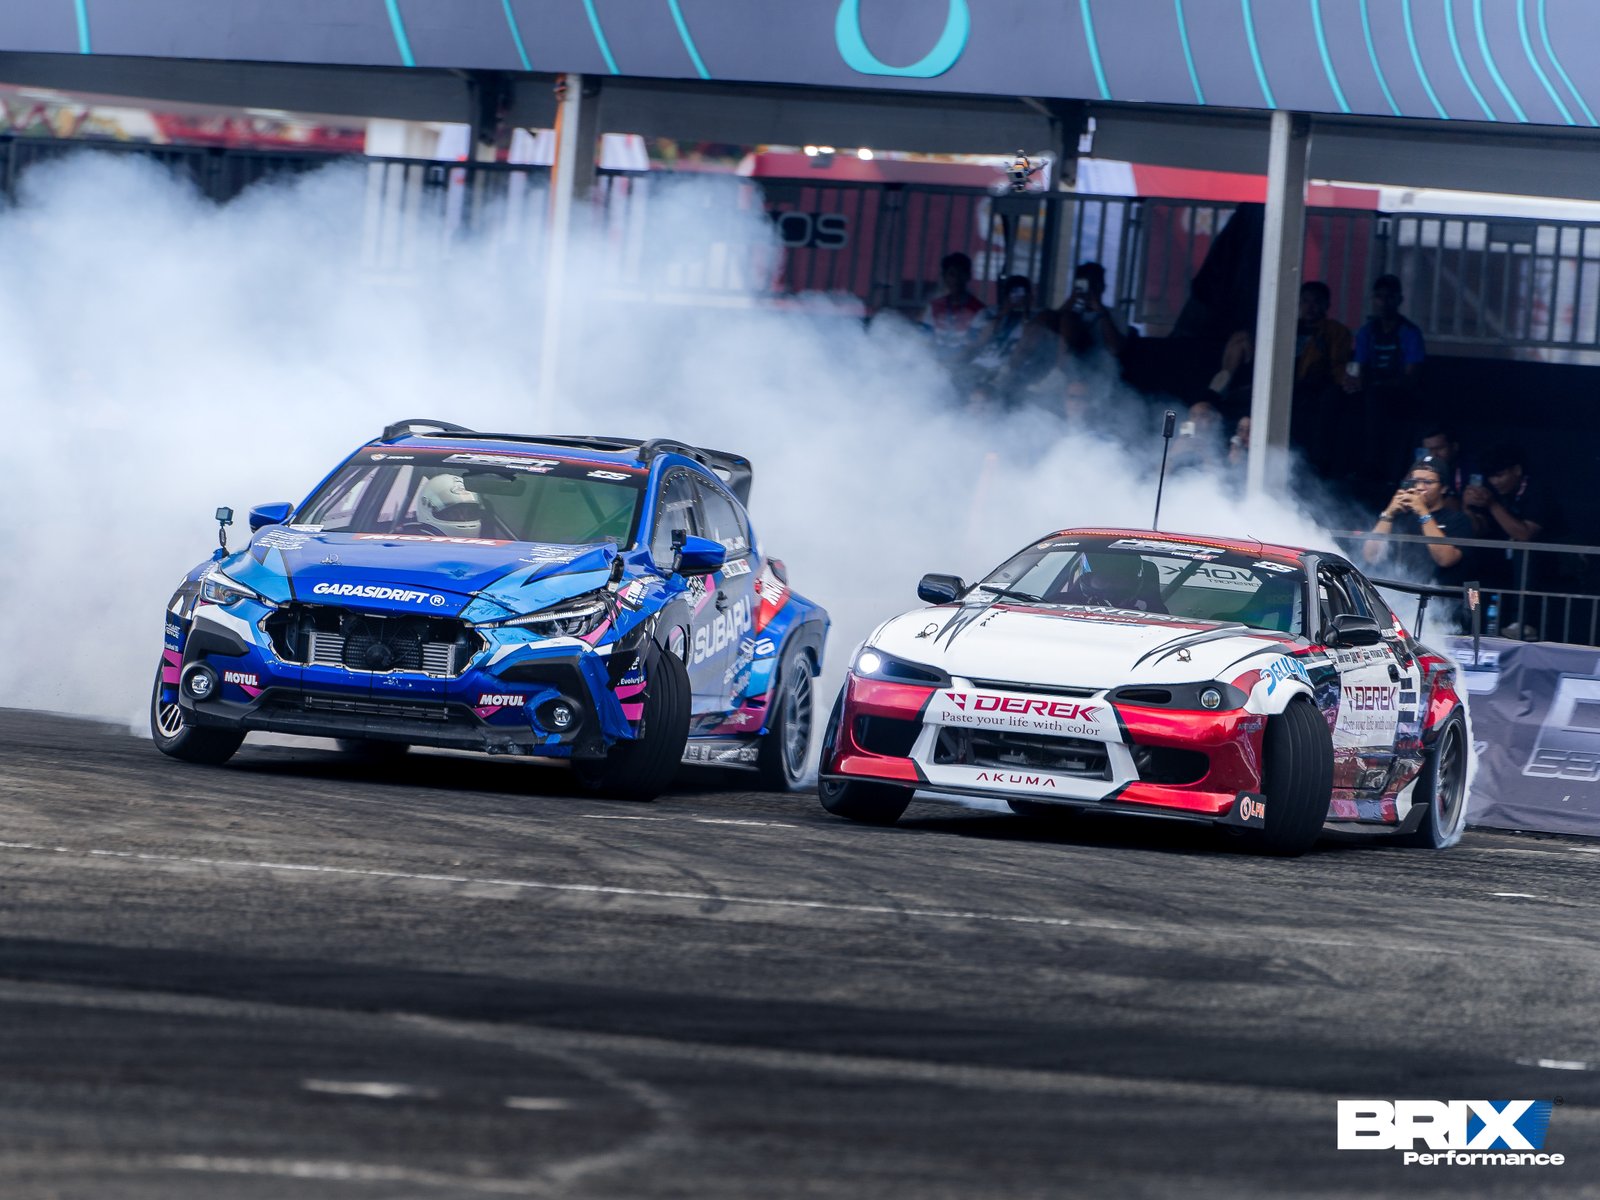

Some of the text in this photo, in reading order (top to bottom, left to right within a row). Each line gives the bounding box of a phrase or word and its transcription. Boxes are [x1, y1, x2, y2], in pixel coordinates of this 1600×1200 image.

[313, 582, 430, 604] GARASIDRIFT
[694, 594, 752, 665] SUBARU
[224, 671, 258, 686] MOTUL
[480, 694, 525, 706] MOTUL
[974, 695, 1100, 722] DEREK
[1355, 686, 1396, 711] DEREK
[942, 711, 1101, 736] Paste your life with color
[976, 772, 1056, 788] AKUMA
